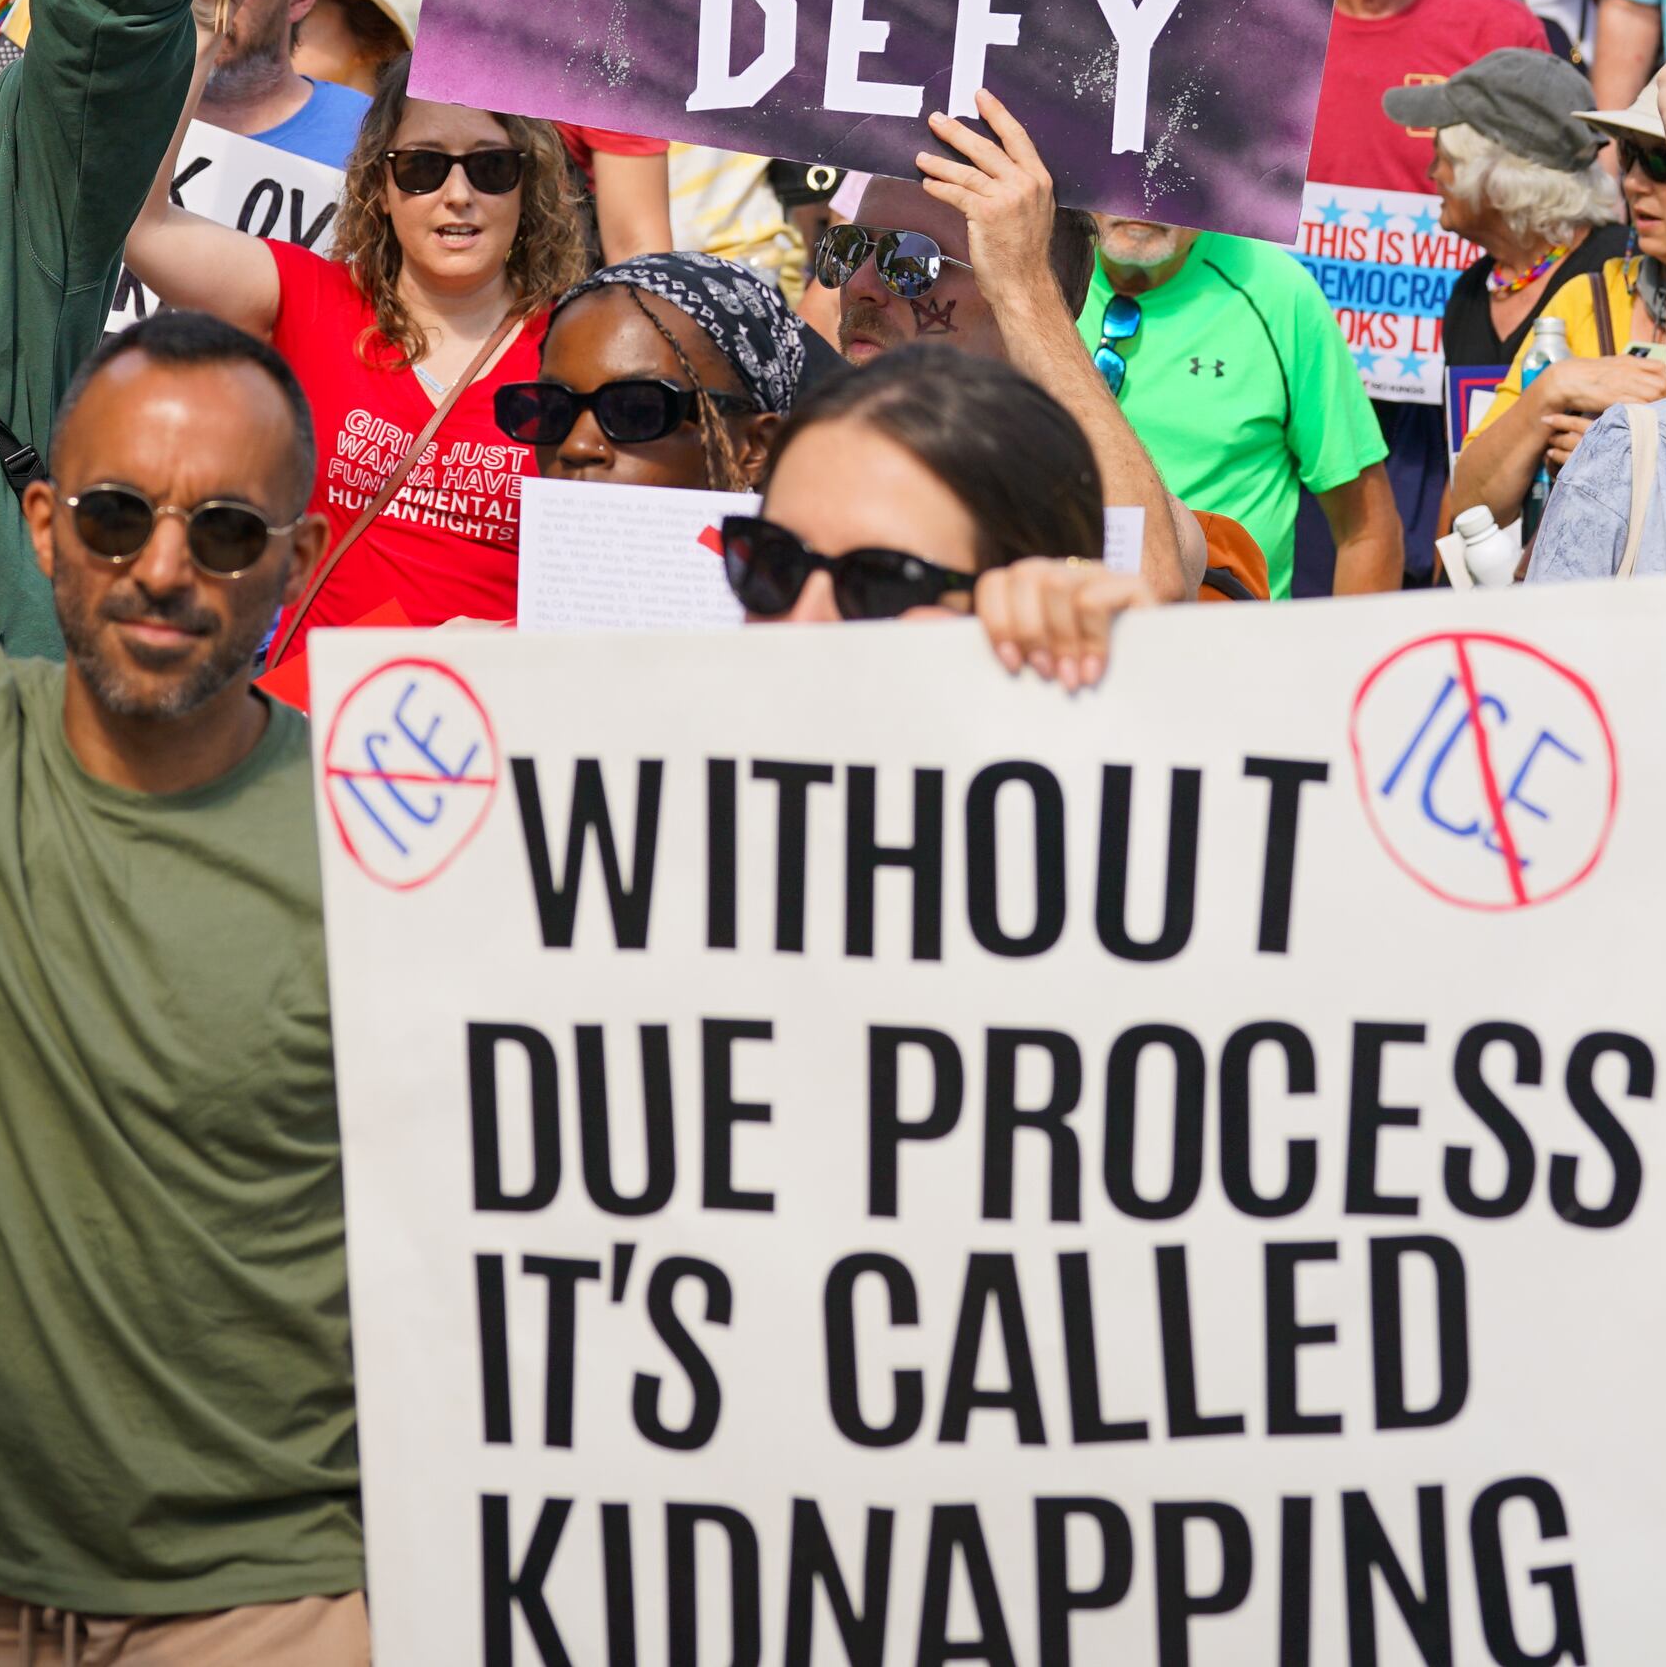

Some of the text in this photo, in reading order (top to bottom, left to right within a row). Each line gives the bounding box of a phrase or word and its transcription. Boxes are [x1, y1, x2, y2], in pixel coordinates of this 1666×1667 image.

[1302, 222, 1486, 269] THIS IS WHA
[422, 508, 514, 541] RIGHTS
[442, 442, 529, 473] JUST
[442, 466, 525, 500] HAVE
[333, 678, 1330, 968] ICE WITHOUT
[1376, 673, 1587, 877] ICE
[462, 1014, 1659, 1232] DUE PROCESS
[472, 1233, 1472, 1454] IT'S CALLED
[476, 1473, 1589, 1667] KIDNAPPING
